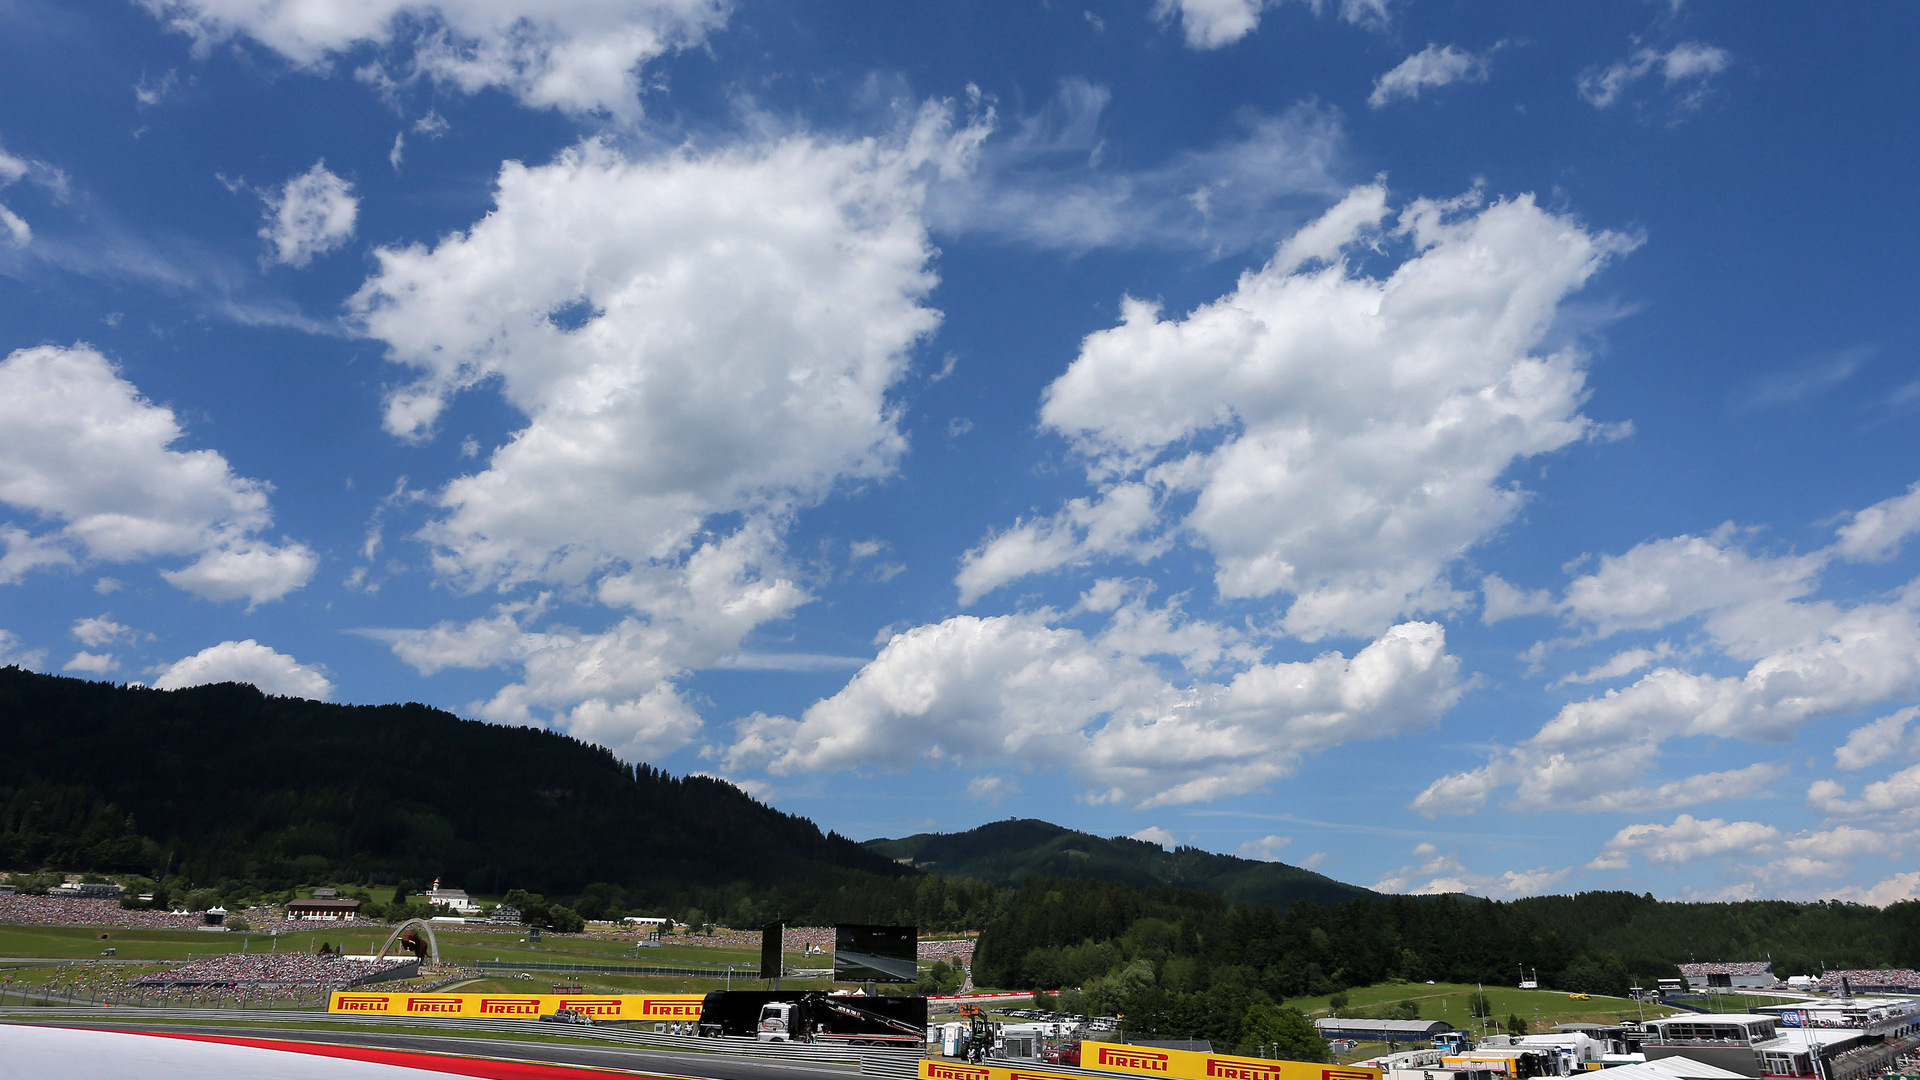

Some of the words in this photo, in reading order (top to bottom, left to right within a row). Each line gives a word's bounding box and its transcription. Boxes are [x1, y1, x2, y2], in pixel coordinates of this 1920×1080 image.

[337, 997, 390, 1011] PIRELLI
[407, 998, 463, 1013] PIRELLI
[480, 999, 541, 1014] PIRELLI
[643, 1000, 704, 1016] PIRELL
[1099, 1048, 1169, 1071] PIRELLI
[1207, 1059, 1281, 1080] PIRELLI
